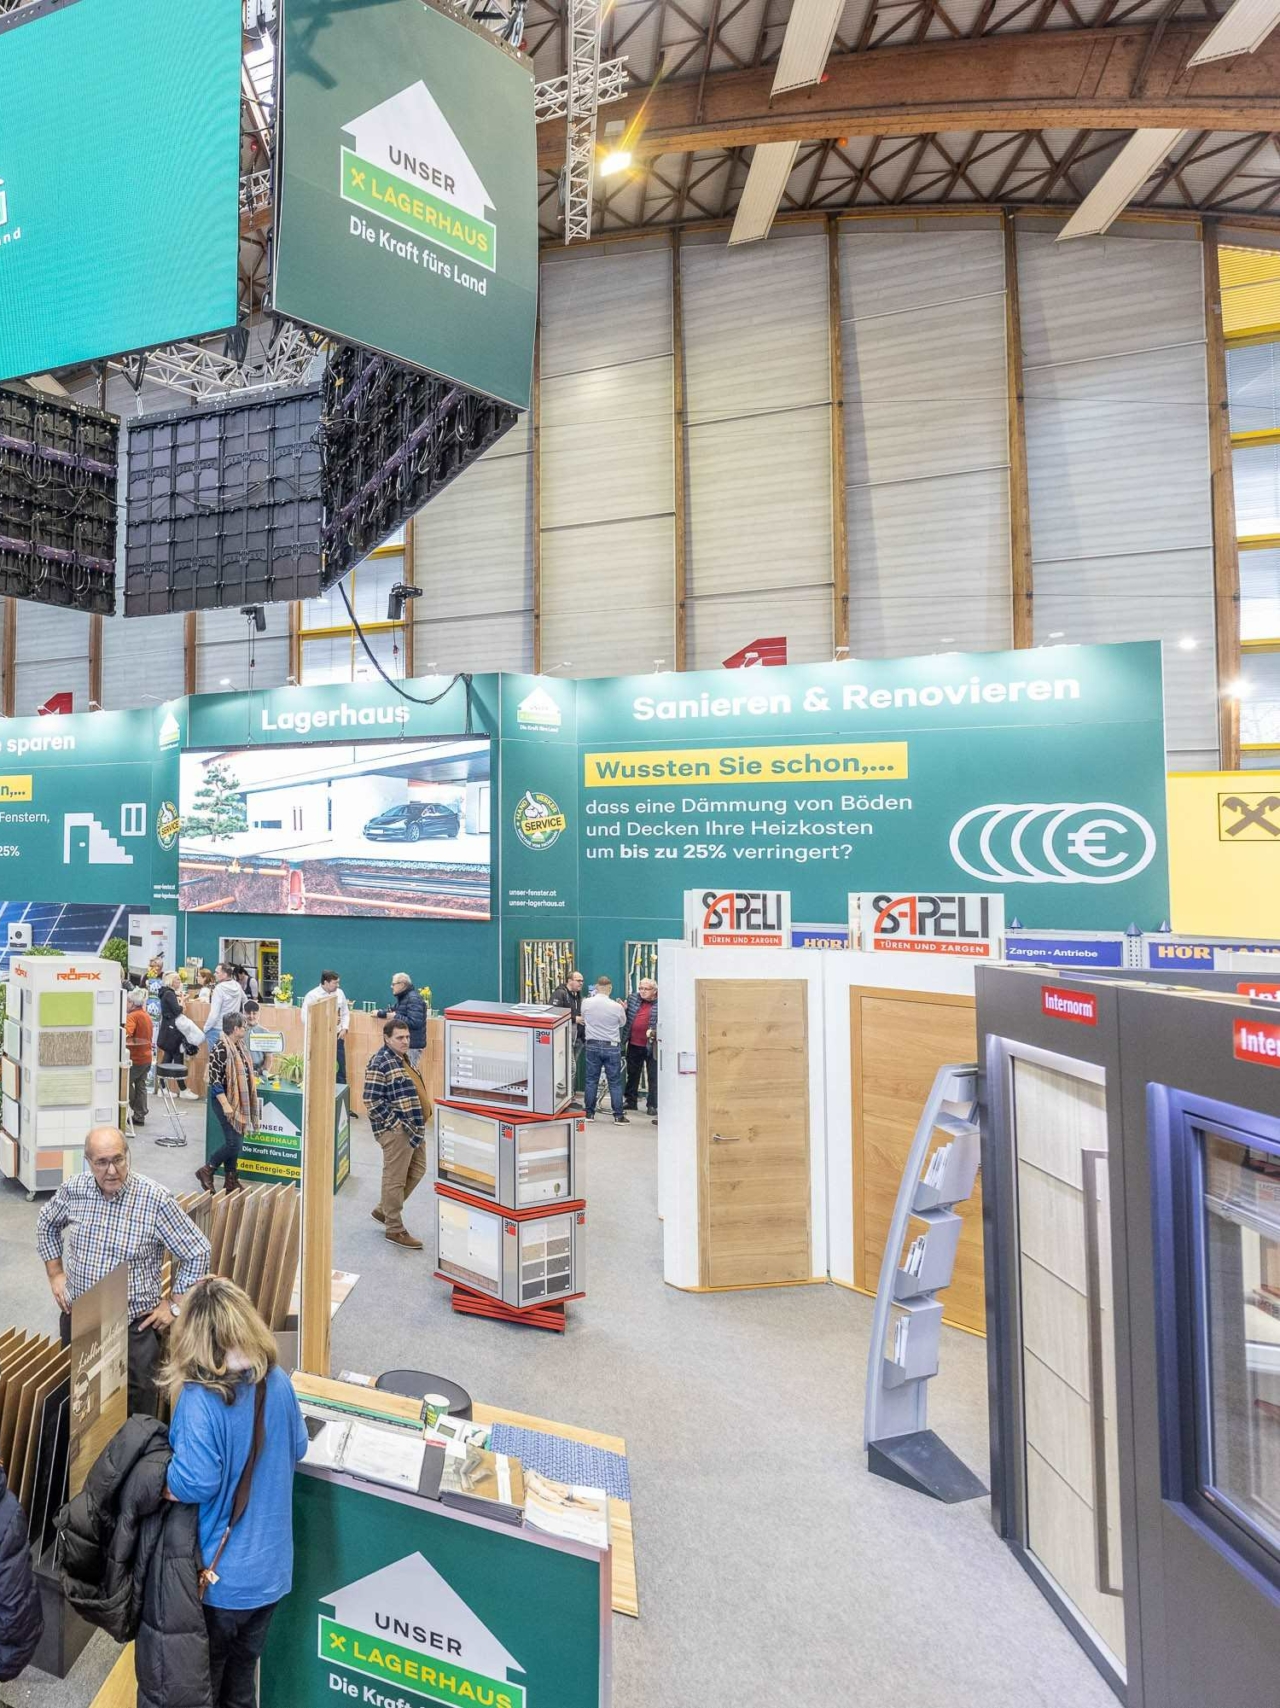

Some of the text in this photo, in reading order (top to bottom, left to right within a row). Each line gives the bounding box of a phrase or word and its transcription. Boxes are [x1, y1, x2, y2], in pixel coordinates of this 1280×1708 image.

[389, 145, 455, 194] UNSER
[372, 178, 488, 251] LAGERHAUS
[350, 215, 487, 296] Die Kraft fürs Land
[632, 676, 1081, 721] Sanieren & Renovieren
[262, 703, 410, 734] Lagerhaus
[7, 735, 75, 756] sparen
[595, 753, 894, 780] Wussten Sie schon,...
[585, 794, 913, 815] dass eine Dämmung von Böden
[0, 811, 50, 824] Fenstern,
[525, 817, 562, 831] SERVICE
[586, 820, 873, 836] und Decken Ihre Heizkosten
[586, 844, 853, 863] um bis zu 25% verringert?
[509, 889, 557, 897] unser-fenster.at
[509, 899, 565, 908] unser-lagerhaus.at
[702, 891, 782, 930] SAPELI
[872, 894, 989, 938] SAPELI
[708, 935, 780, 944] TÜREN UND ZARGEN
[880, 940, 984, 953] TÜREN UND ZARGEN
[1009, 947, 1098, 957] Zargen Antriebe
[56, 968, 101, 980] RÖFIX
[1045, 992, 1093, 1018] Internorm
[250, 1134, 298, 1146] LAGERHAUS
[253, 1147, 269, 1155] Kraft
[270, 1149, 281, 1157] fürs
[282, 1151, 298, 1159] Land
[240, 1162, 254, 1170] den
[374, 1612, 462, 1656] UNSER
[353, 1641, 512, 1708] LAGERHAUS
[329, 1673, 359, 1698] Die
